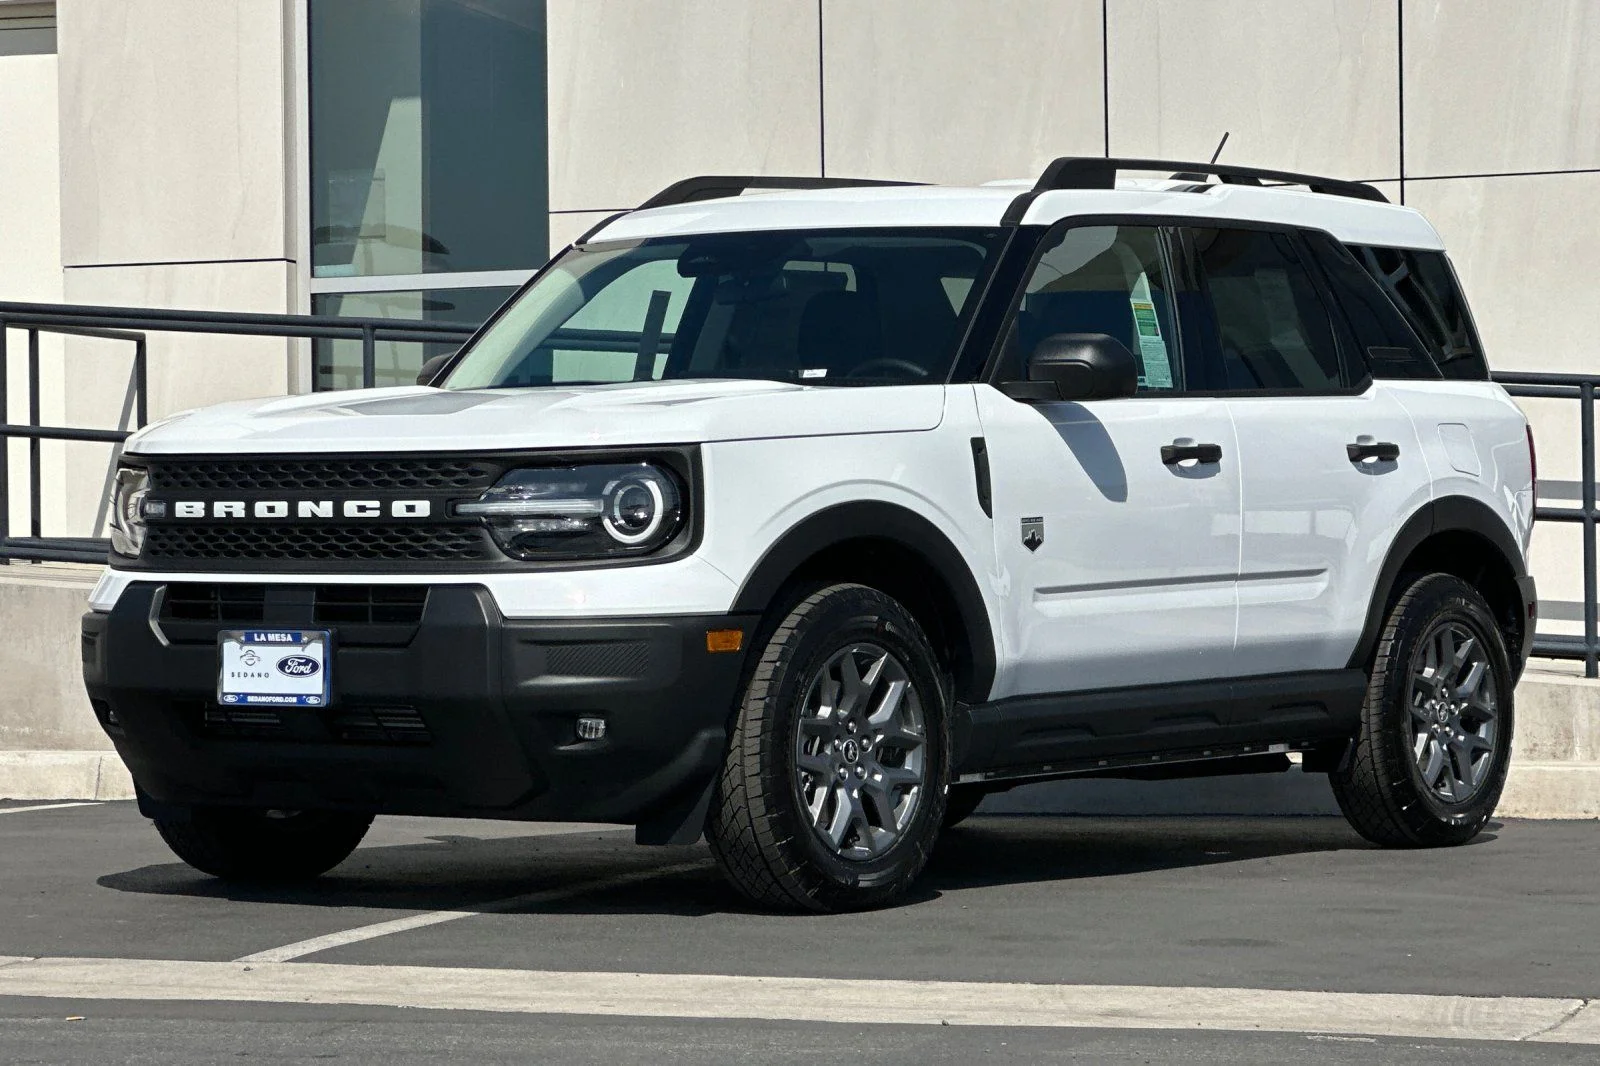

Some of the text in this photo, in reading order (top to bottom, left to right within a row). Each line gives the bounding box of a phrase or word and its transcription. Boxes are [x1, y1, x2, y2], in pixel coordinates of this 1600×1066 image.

[174, 500, 431, 518] BRONCO
[254, 633, 293, 642] LA MESA
[285, 658, 312, 674] Ford
